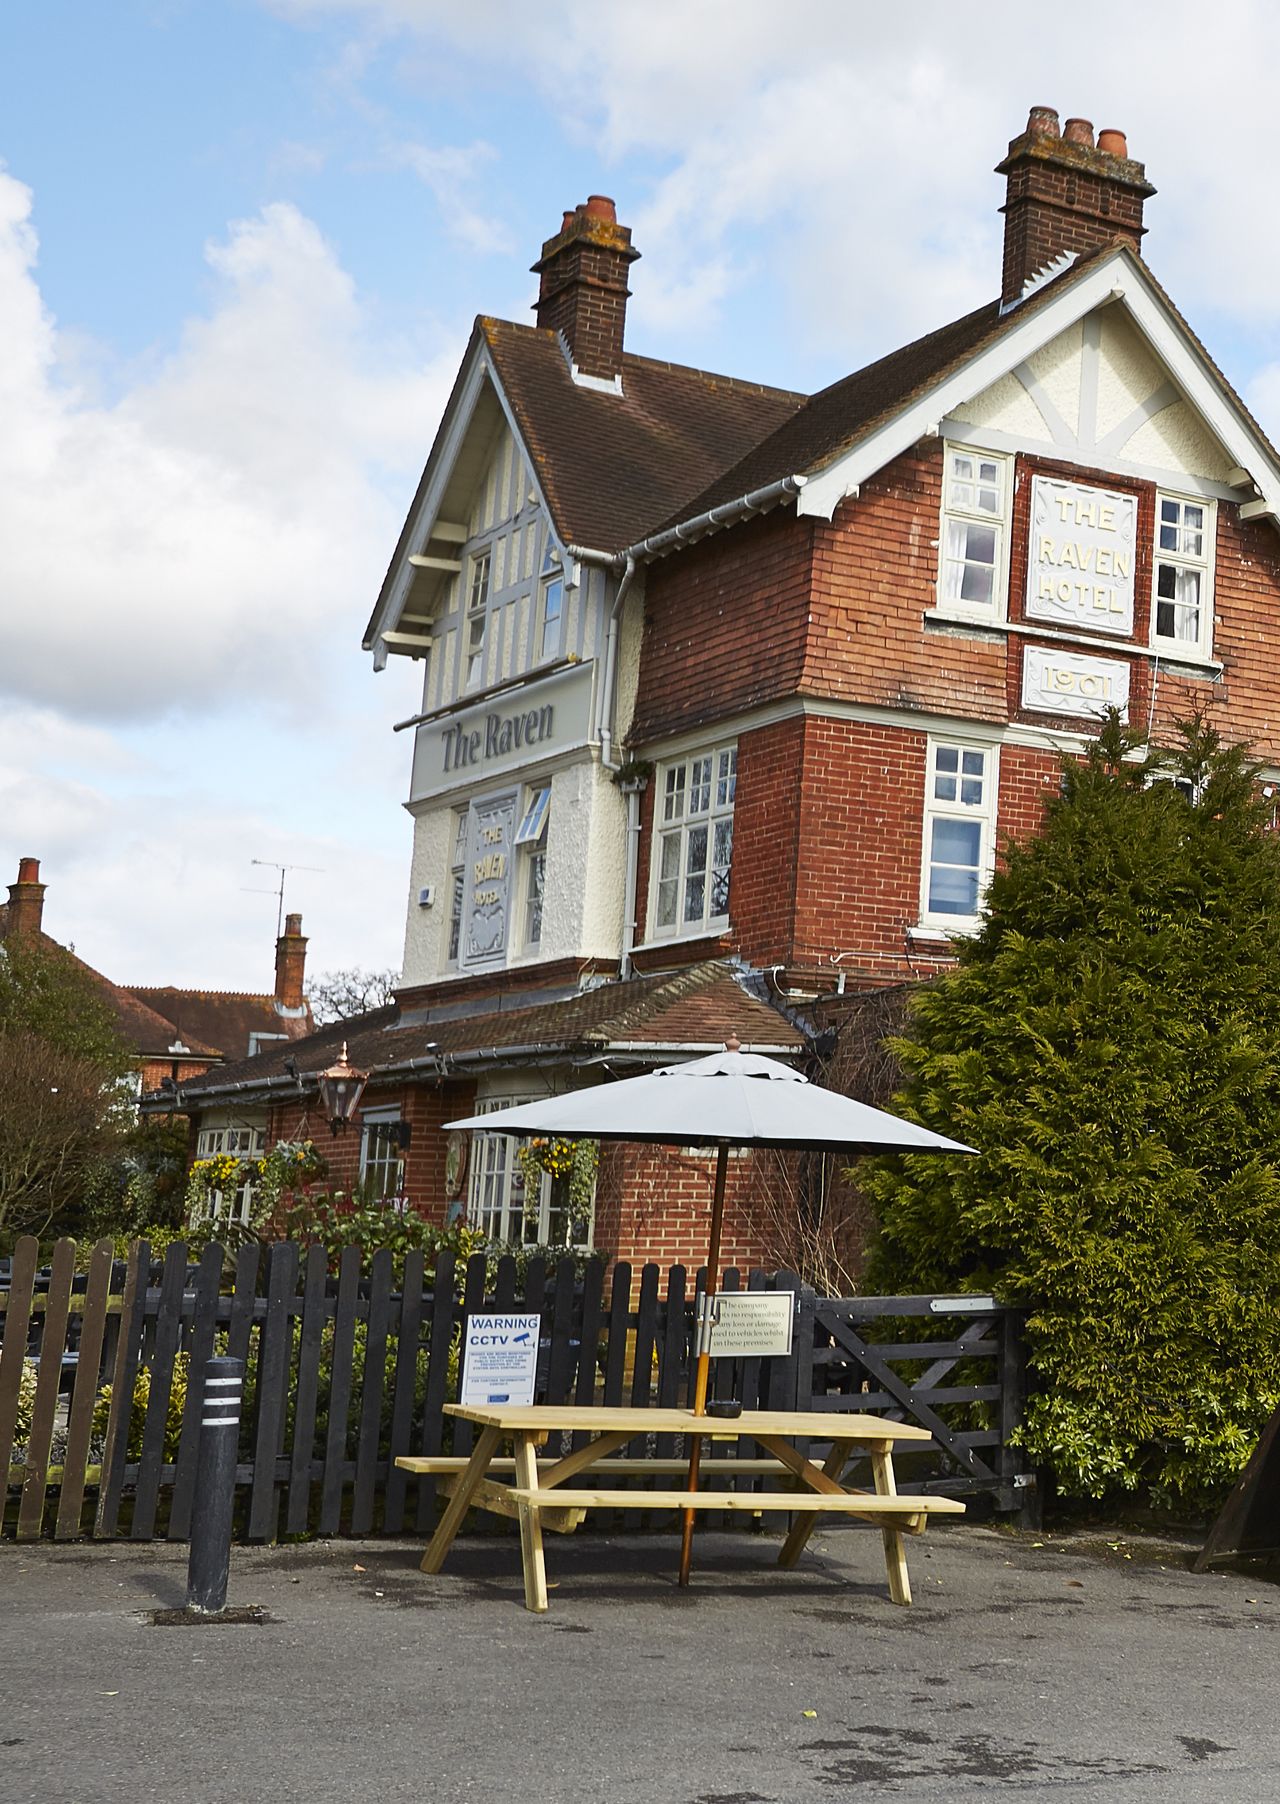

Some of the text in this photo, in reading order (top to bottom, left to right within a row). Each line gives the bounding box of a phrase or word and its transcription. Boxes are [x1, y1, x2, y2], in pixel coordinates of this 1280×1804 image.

[1055, 496, 1116, 532] THE
[1038, 535, 1129, 579] RAVEN
[1039, 576, 1124, 614] HOTEL
[1045, 666, 1110, 698] 1901
[441, 704, 555, 773] The Raven
[481, 826, 503, 847] THE
[474, 853, 506, 887] RAVEN
[470, 1335, 509, 1346] CCTV
[471, 1318, 538, 1329] WARNING
